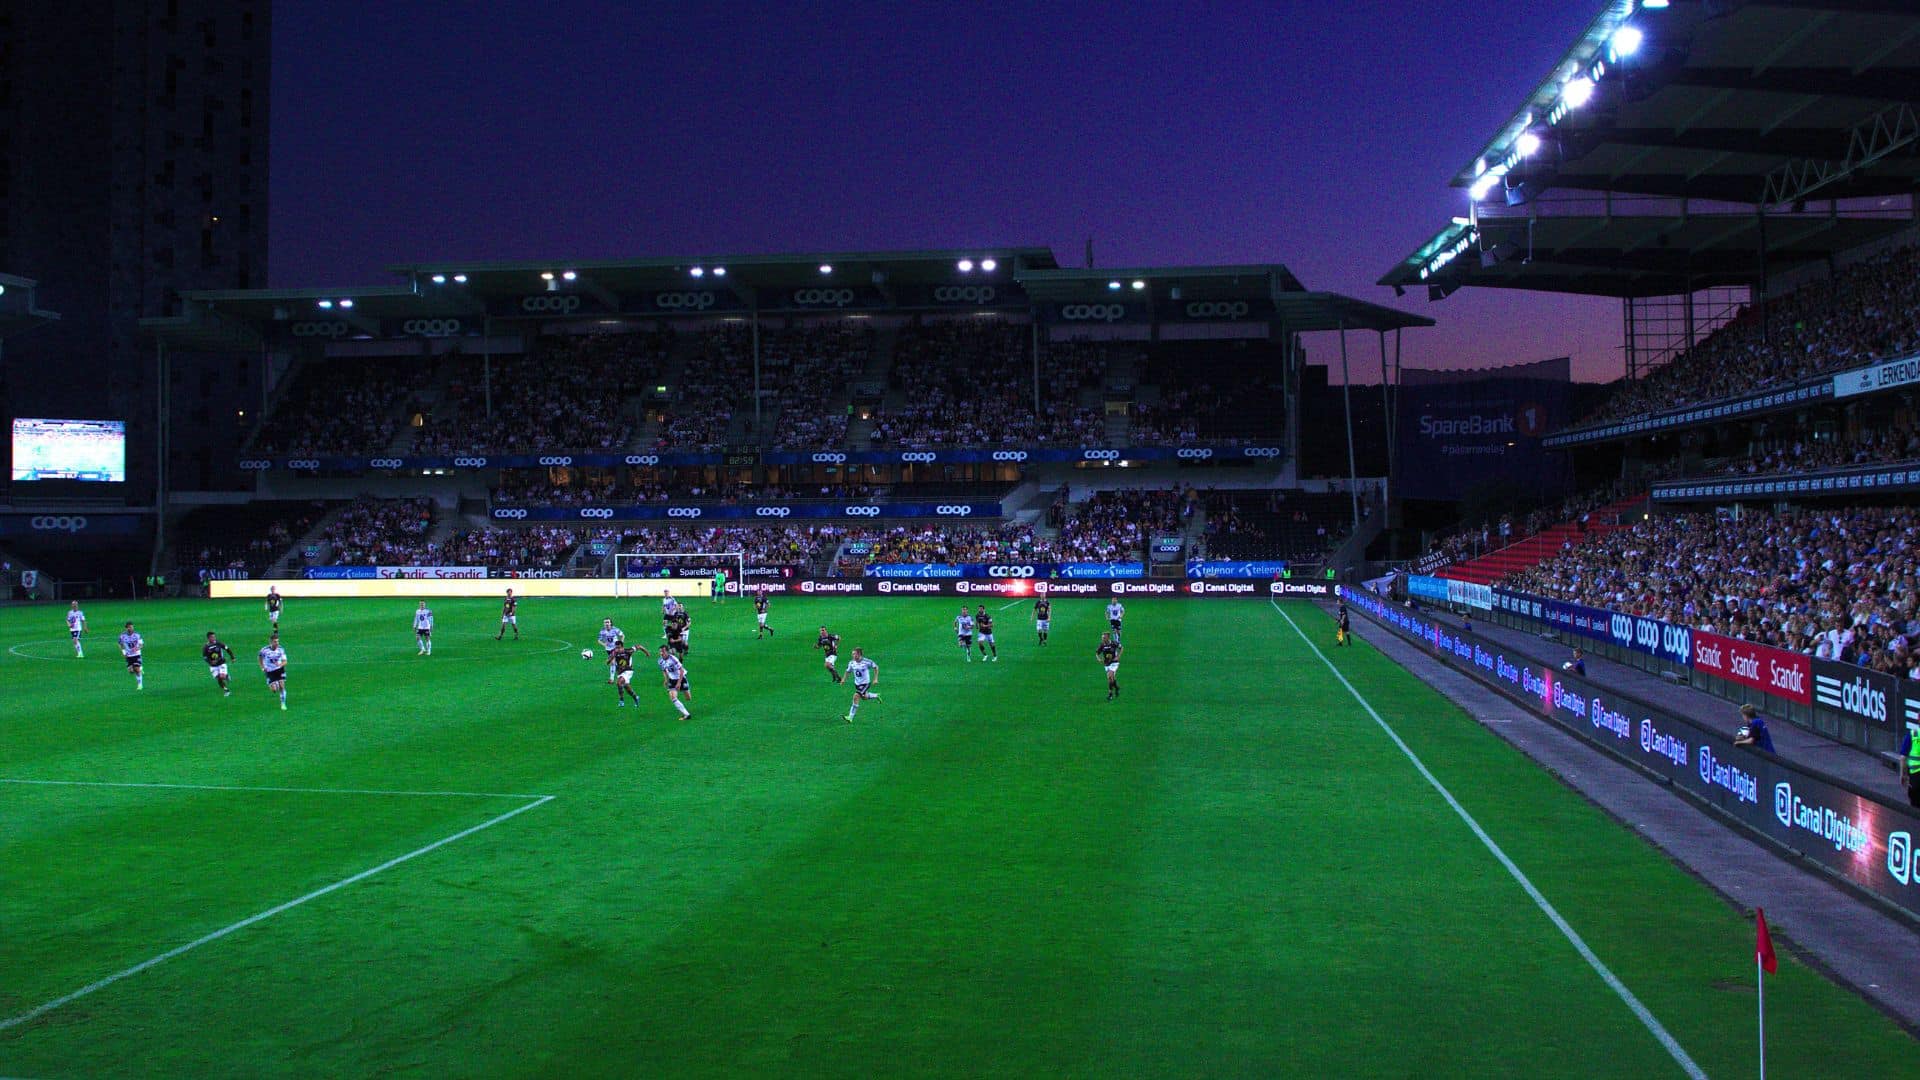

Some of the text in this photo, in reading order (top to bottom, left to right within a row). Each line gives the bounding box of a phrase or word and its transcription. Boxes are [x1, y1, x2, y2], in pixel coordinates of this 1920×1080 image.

[656, 291, 715, 310] coop
[794, 288, 854, 306] coop
[934, 286, 995, 304] coop
[522, 296, 580, 314] coop
[1186, 301, 1249, 320] coop
[1062, 303, 1125, 321] coop
[292, 321, 348, 337] coop
[403, 318, 460, 335] coop
[1420, 413, 1515, 439] SpareBank
[812, 452, 846, 464] coop
[902, 451, 936, 463] coop
[993, 450, 1028, 462] coop
[1084, 449, 1119, 461] coop
[1177, 447, 1213, 459] coop
[1244, 447, 1280, 459] coop
[240, 459, 272, 471] coop
[288, 458, 320, 470] coop
[370, 458, 402, 470] coop
[454, 456, 487, 468] coop
[539, 455, 572, 466] coop
[625, 455, 659, 466] coop
[494, 508, 528, 519] coop
[580, 507, 614, 519] coop
[667, 507, 701, 519] coop
[756, 506, 791, 518] coop
[846, 505, 880, 517] coop
[936, 504, 971, 516] coop
[31, 515, 87, 533] coop
[381, 568, 482, 579] Scndic Scandic
[515, 568, 562, 579] adidas
[882, 566, 912, 577] telenor
[929, 566, 961, 577] telenor
[988, 565, 1035, 578] coop
[1073, 566, 1101, 576] telenor
[1115, 566, 1143, 576] telenor
[1202, 565, 1235, 575] telenor
[761, 583, 785, 592] Digital
[815, 582, 863, 593] Canal Digital
[892, 582, 940, 593] Canal Digital
[970, 583, 992, 591] Canal
[1049, 583, 1097, 593] Canal Digital
[1126, 583, 1175, 593] Canal Digital
[1205, 583, 1255, 593] Canal Digital
[1285, 583, 1305, 593] Canal
[1611, 613, 1633, 648] coop
[1636, 618, 1659, 654] coop
[1663, 625, 1690, 664] coop
[1696, 642, 1804, 695] Scandic Scandic Scandic
[1842, 676, 1887, 722] adidas
[1651, 728, 1687, 766] Canal Digital
[1711, 757, 1758, 804] Canal Digital
[1793, 796, 1823, 836] Canal
